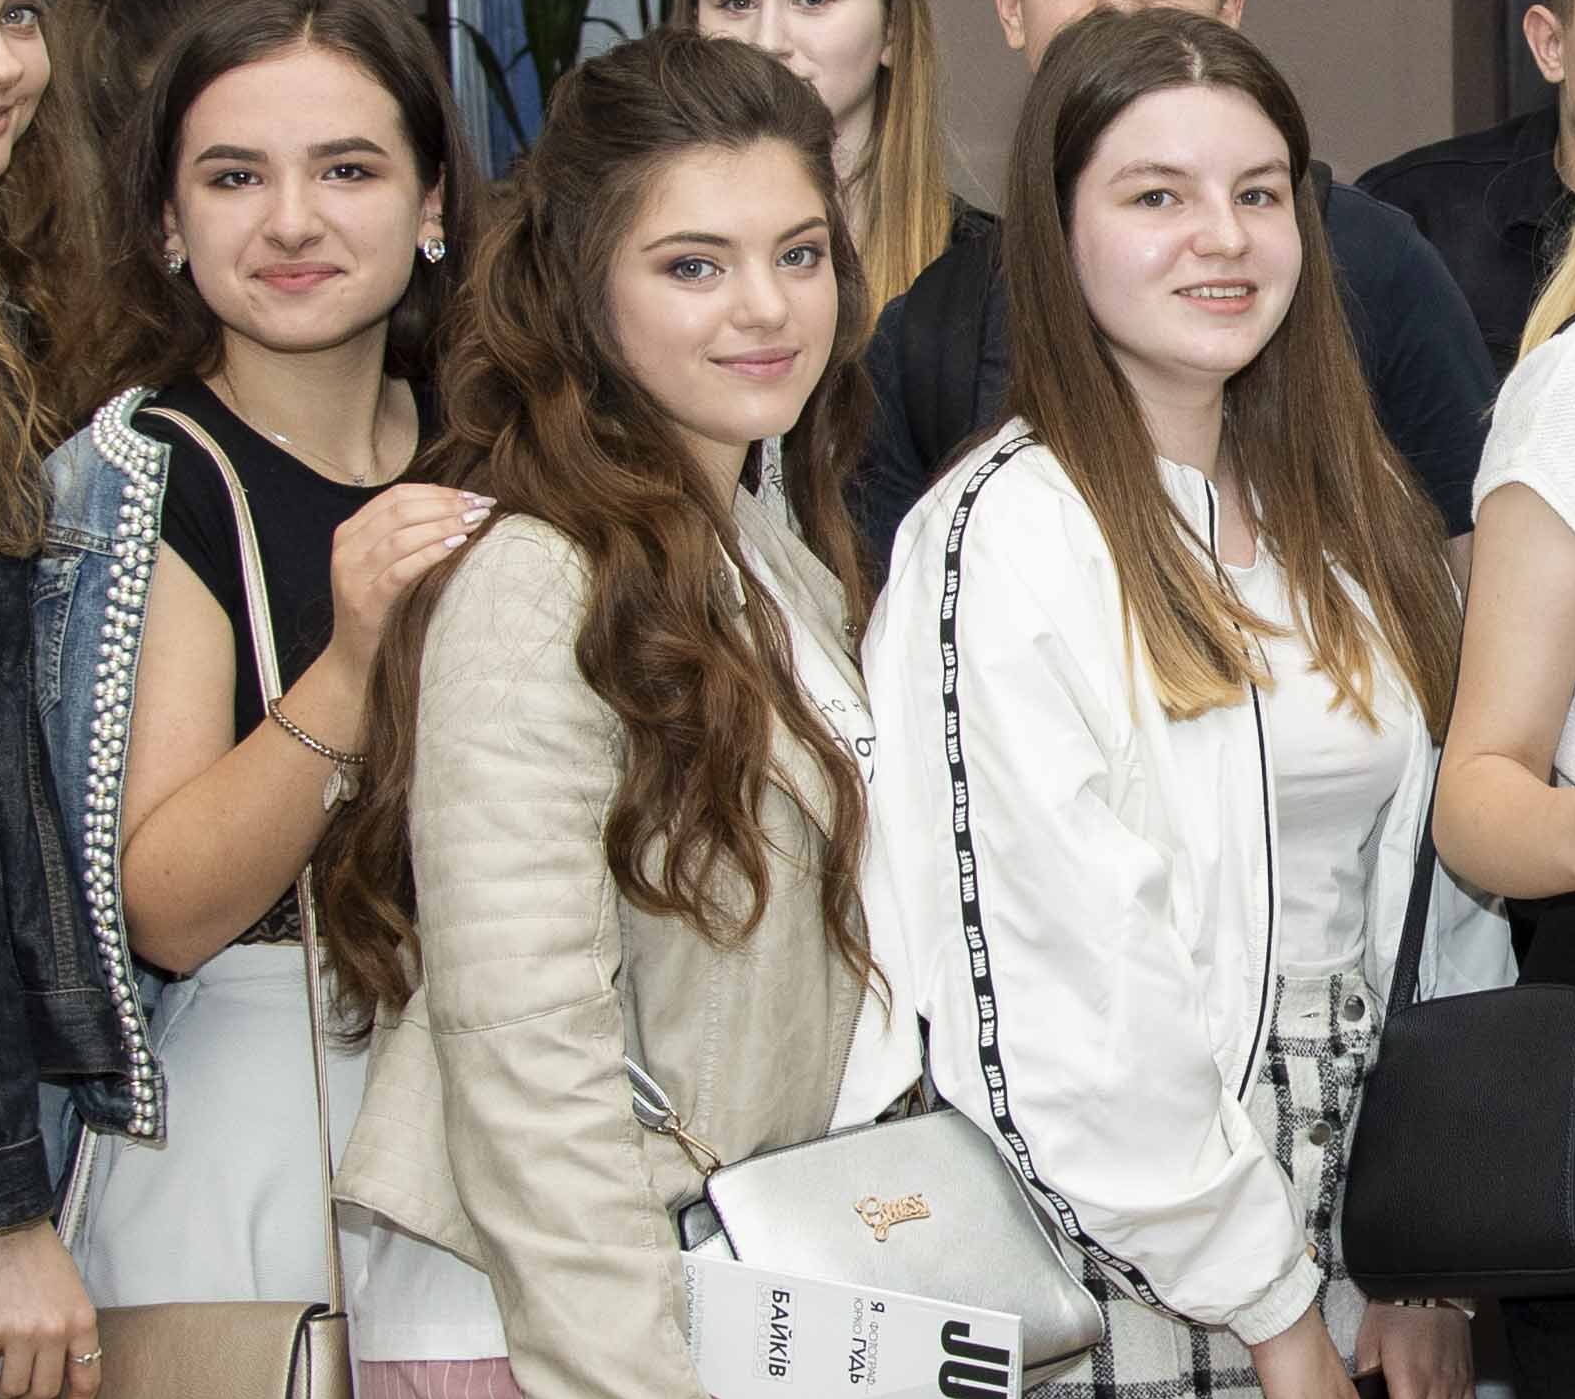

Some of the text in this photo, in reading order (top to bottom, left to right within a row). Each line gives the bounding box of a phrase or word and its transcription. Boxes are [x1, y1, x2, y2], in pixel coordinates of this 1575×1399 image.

[941, 570, 958, 620] ONE OFF
[942, 642, 957, 694] ONE OFF
[946, 711, 960, 764] ONE OFF
[954, 781, 967, 833] ONE OFF
[959, 850, 975, 902] ONE OFF
[966, 925, 987, 978] ONE OFF
[978, 994, 995, 1047] ONE OFF
[985, 1064, 1006, 1117] ONE OFF
[870, 1301, 884, 1312] Я
[847, 1337, 866, 1384] ГУДЬ
